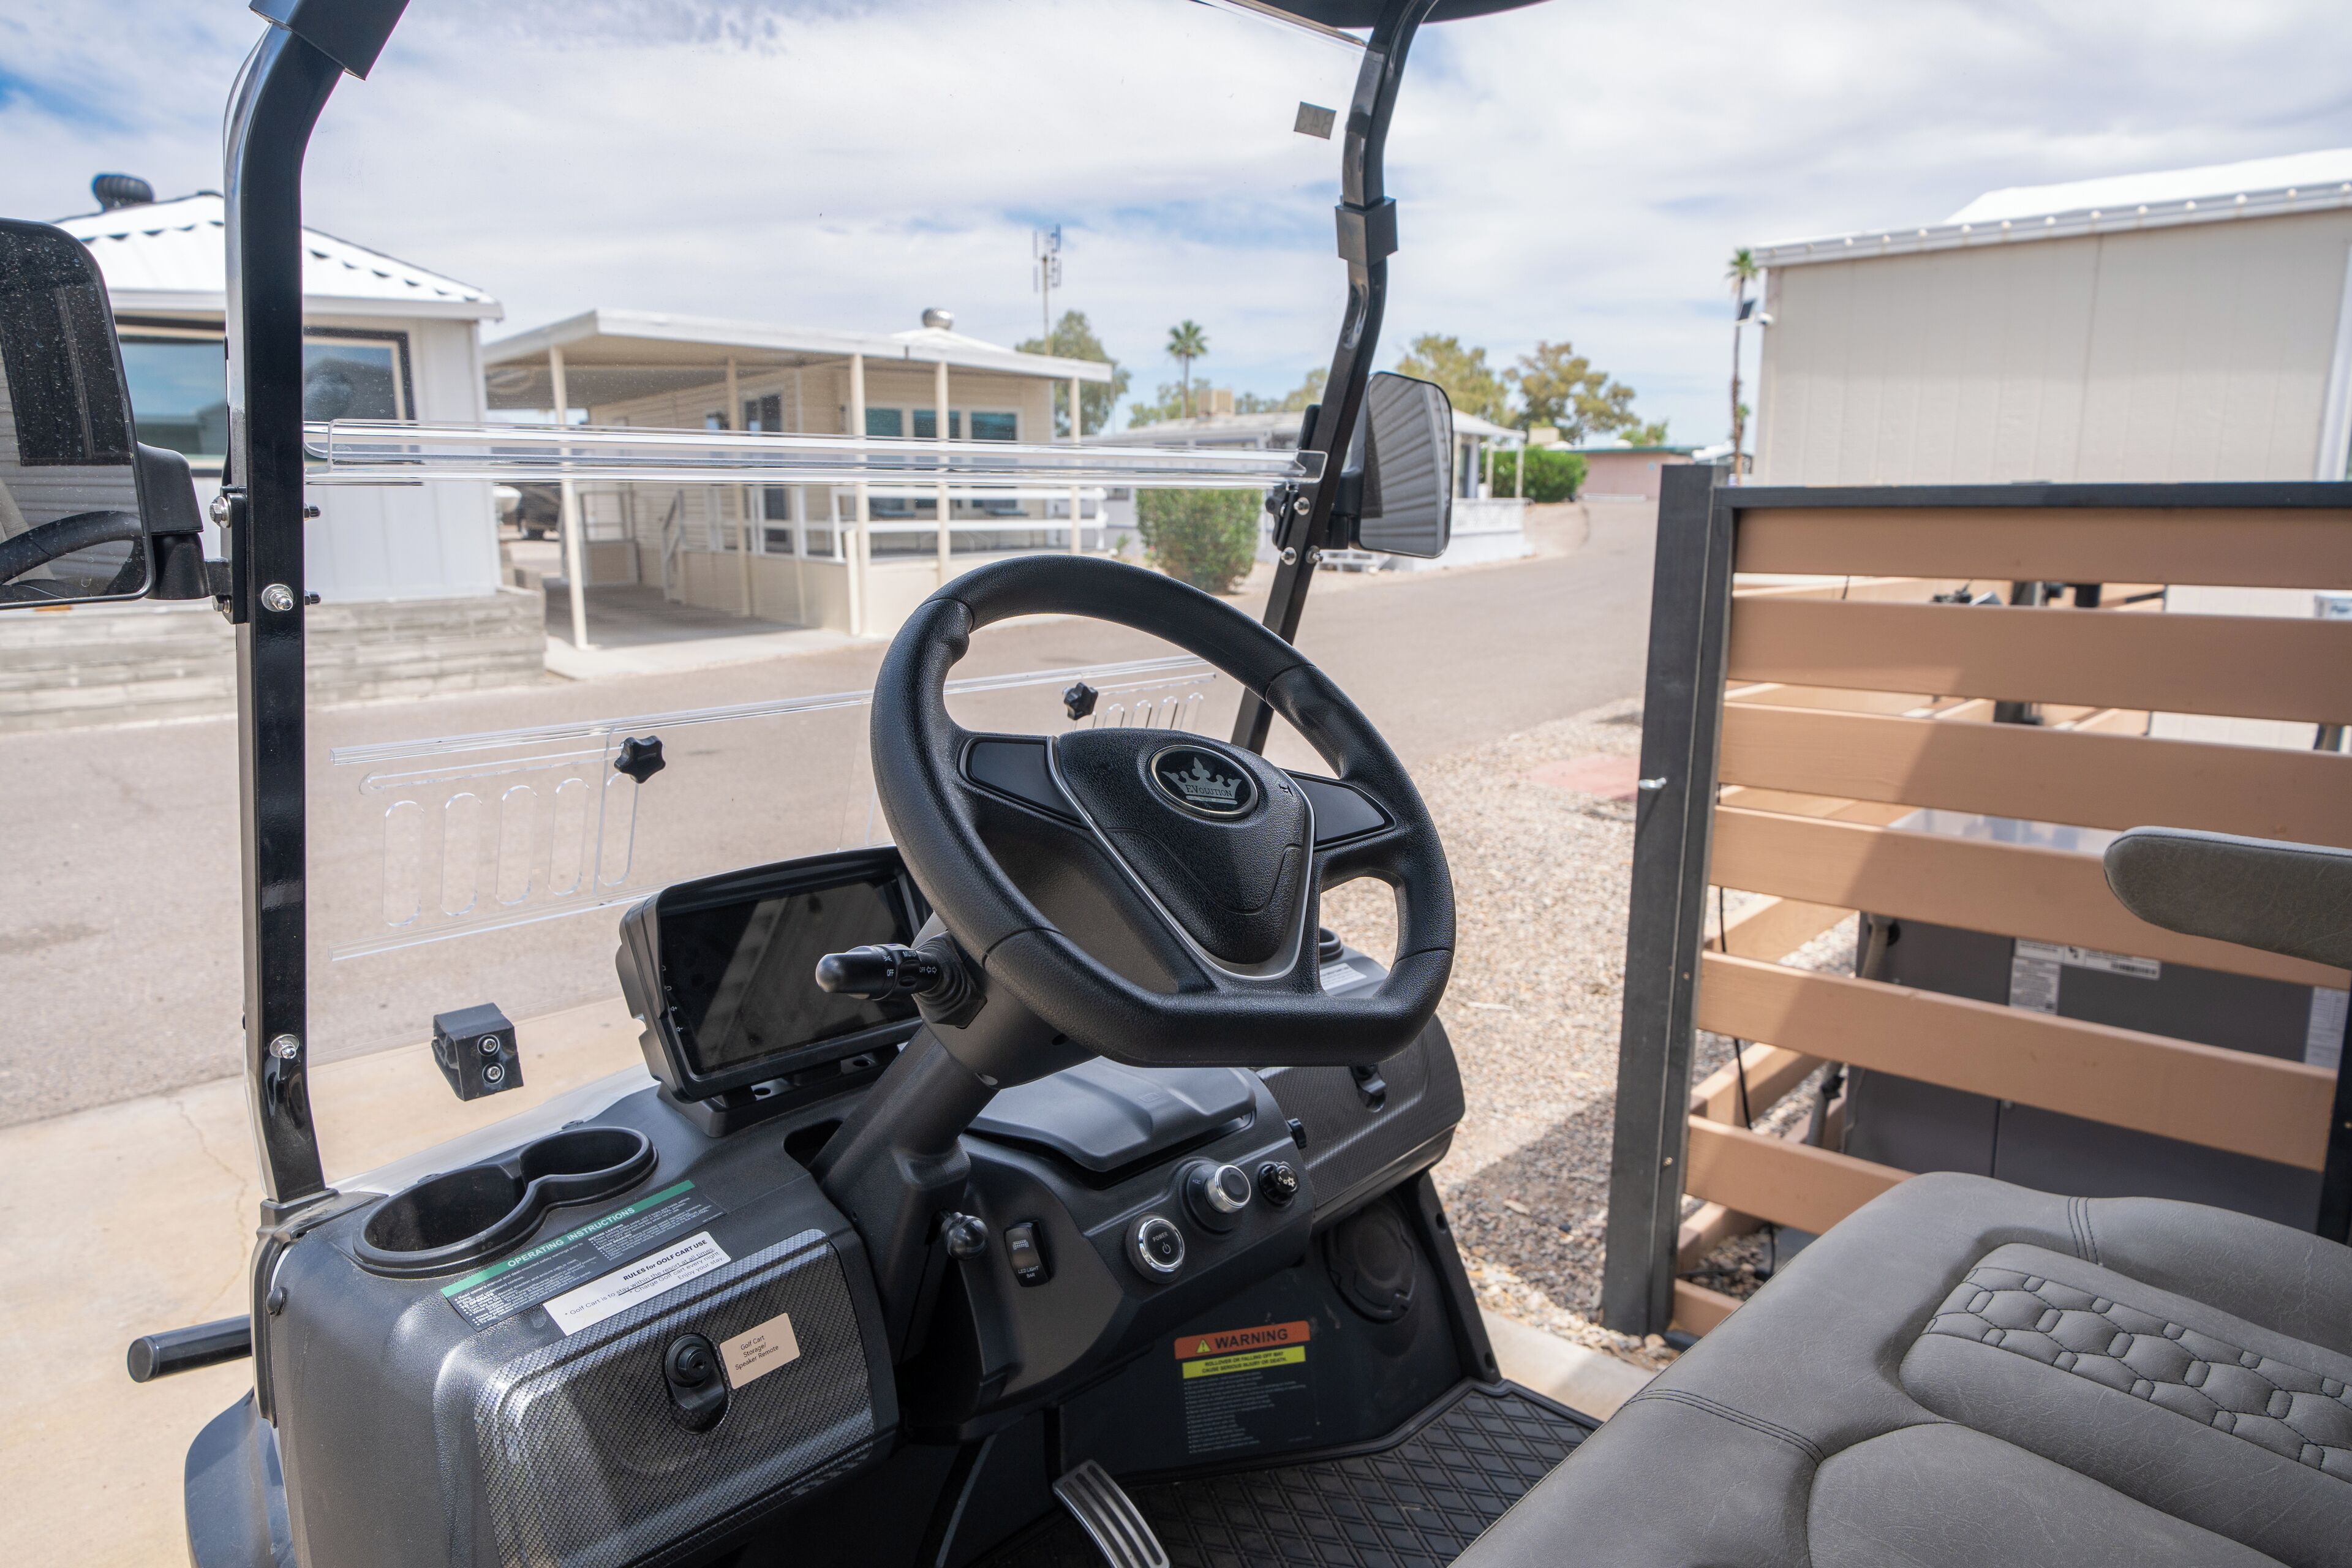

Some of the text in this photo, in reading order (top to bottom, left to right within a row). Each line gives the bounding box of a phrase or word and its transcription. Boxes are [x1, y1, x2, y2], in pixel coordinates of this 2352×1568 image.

[506, 1207, 635, 1267] OPERATING INSTRUCTIONS
[587, 1223, 624, 1241] BEFORE LEAVING
[1152, 1231, 1169, 1242] POWER
[622, 1267, 646, 1281] RULES
[655, 1254, 676, 1265] GOLF
[674, 1245, 694, 1257] CART
[693, 1239, 707, 1248] USE
[634, 1251, 719, 1292] Charge Golf cart every night
[677, 1270, 695, 1279] Enjoy
[695, 1263, 710, 1272] your
[569, 1305, 584, 1314] Golf
[584, 1298, 600, 1307] Cart
[630, 1276, 650, 1287] within
[662, 1262, 680, 1272] resort
[469, 1292, 494, 1305] OPERATE
[740, 1334, 764, 1351] Golf Cart
[1215, 1328, 1288, 1349] WARNING
[734, 1345, 778, 1370] Speaker Remote
[742, 1341, 767, 1357] Storage/
